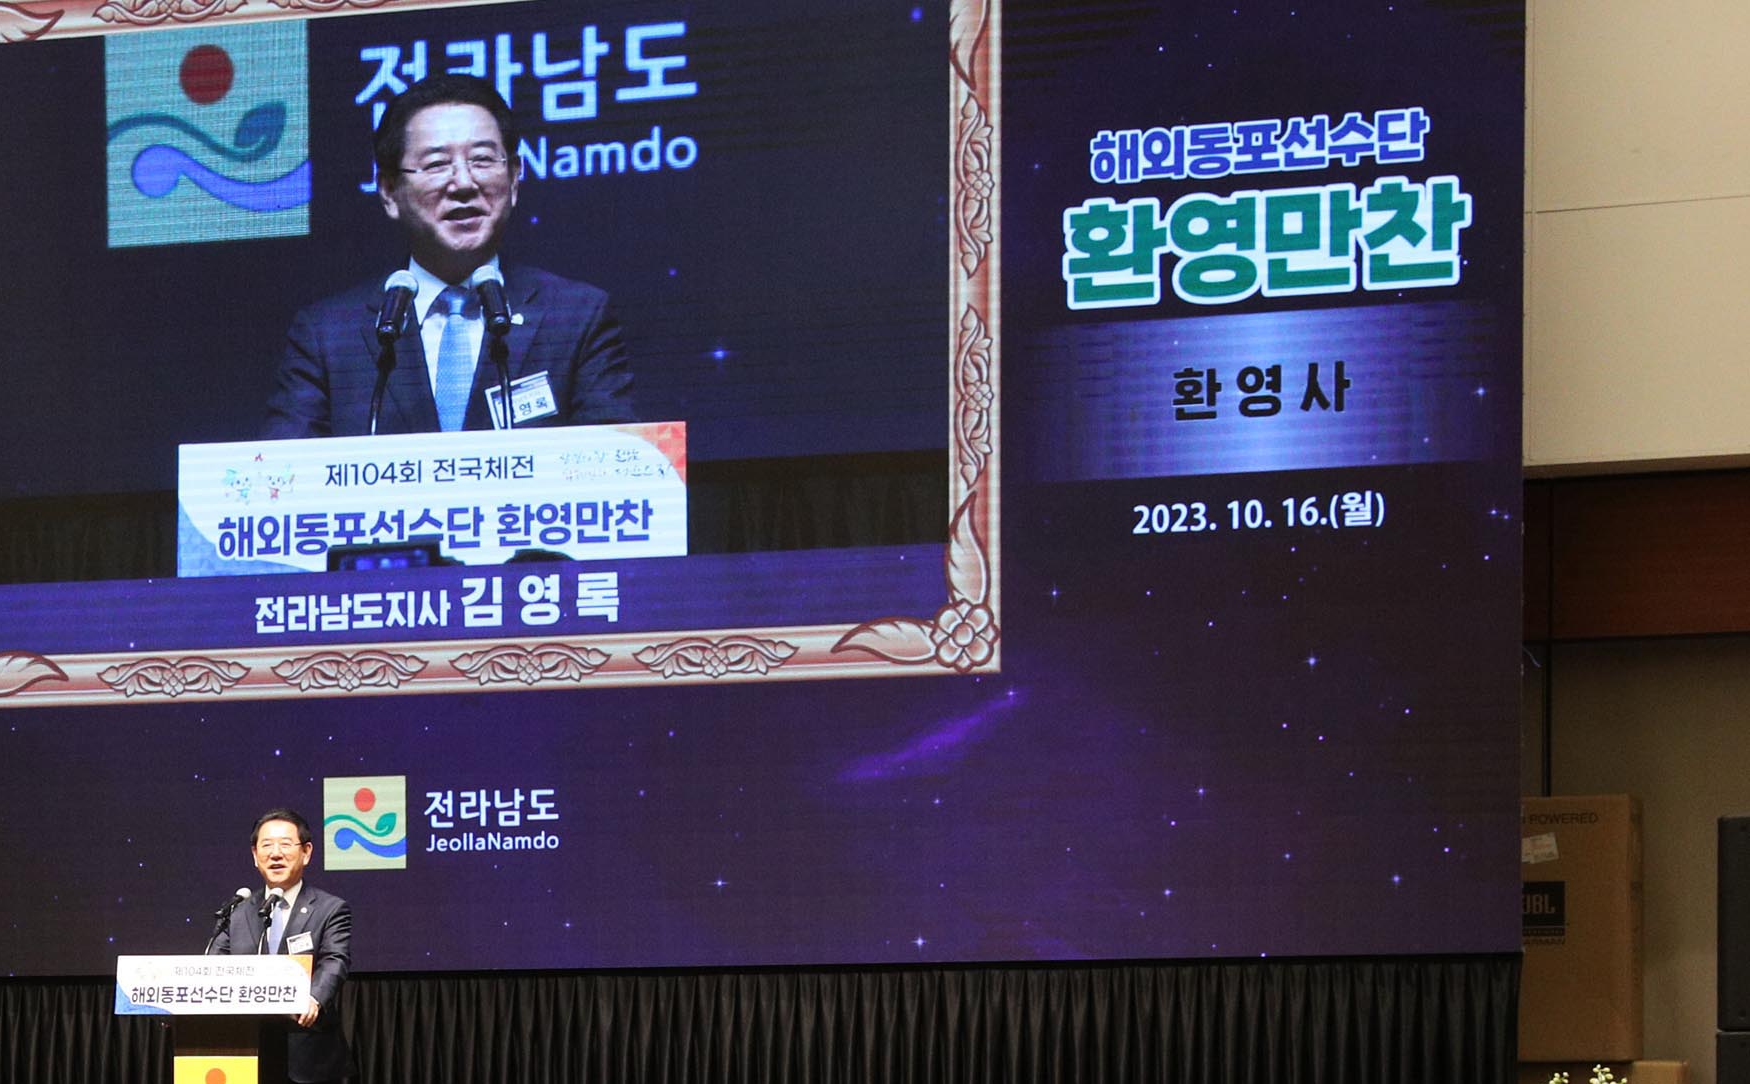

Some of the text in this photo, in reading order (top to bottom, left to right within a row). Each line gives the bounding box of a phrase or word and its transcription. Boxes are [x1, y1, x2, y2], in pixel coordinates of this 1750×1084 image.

[354, 22, 698, 131] 전라남도
[1089, 107, 1430, 183] 해외동포선수단
[1062, 175, 1473, 310] 환영만찬
[325, 459, 423, 488] 제104회
[433, 455, 535, 482] 전국체전
[496, 498, 654, 547] 환영만찬
[1132, 502, 1217, 535] 2023.
[1226, 498, 1272, 531] 10.
[255, 590, 450, 634] 전라남도지사
[424, 788, 559, 828] 전라남도
[426, 830, 559, 852] JeollaNamdo
[131, 985, 298, 1004] 해외동포선수단 환영만찬
